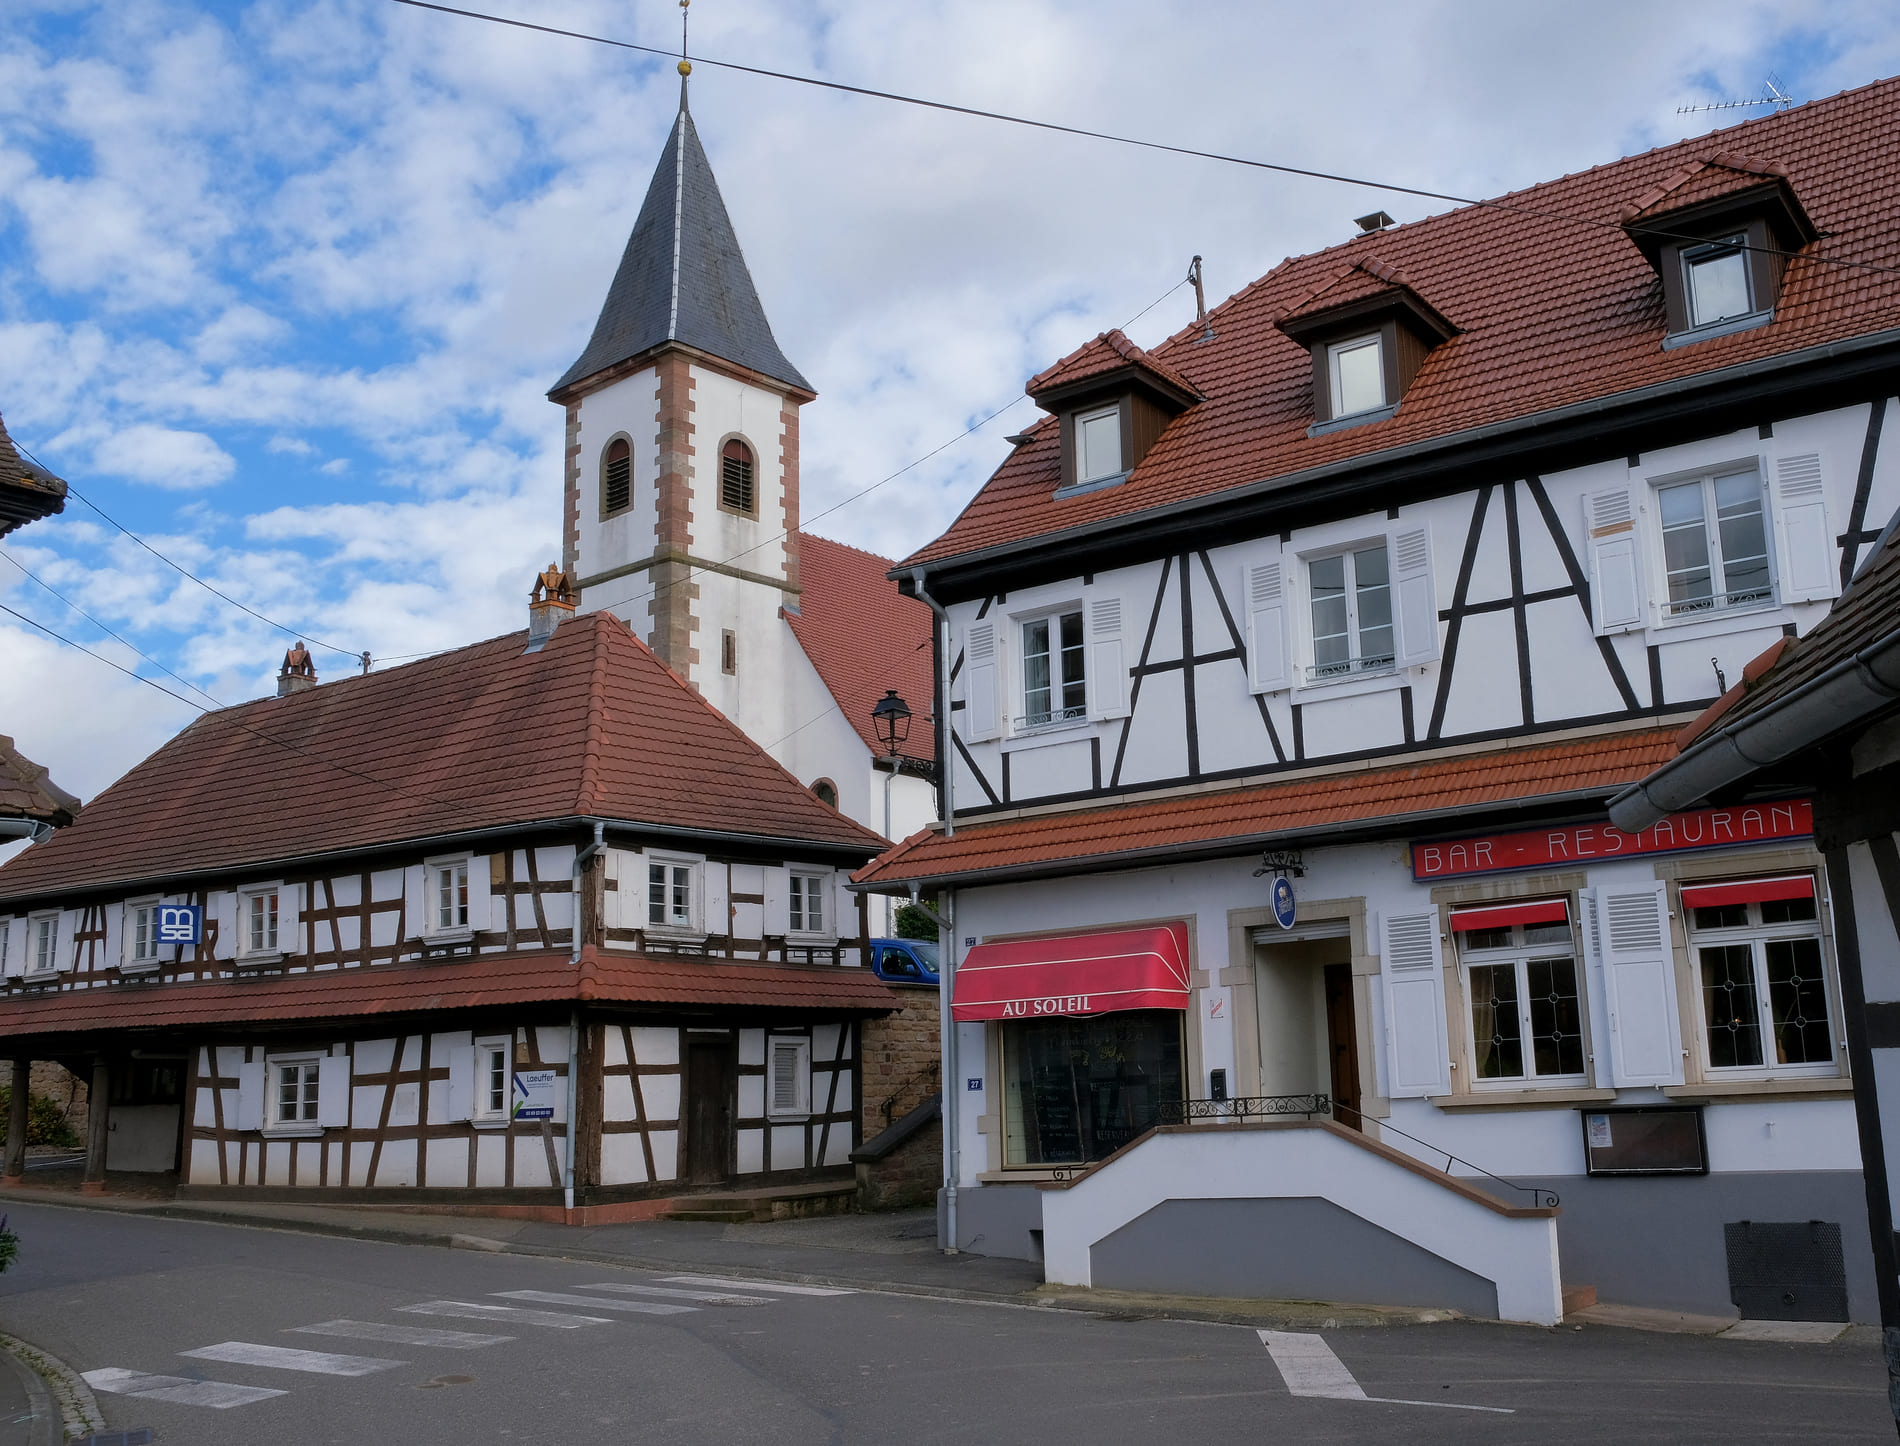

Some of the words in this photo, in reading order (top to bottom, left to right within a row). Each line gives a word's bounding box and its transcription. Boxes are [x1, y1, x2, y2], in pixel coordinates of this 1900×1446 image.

[1423, 841, 1494, 874] BAR
[1547, 802, 1812, 859] RESAURAN
[1002, 1000, 1027, 1017] AU
[1033, 995, 1092, 1014] SOLEIL
[970, 1080, 979, 1089] 27
